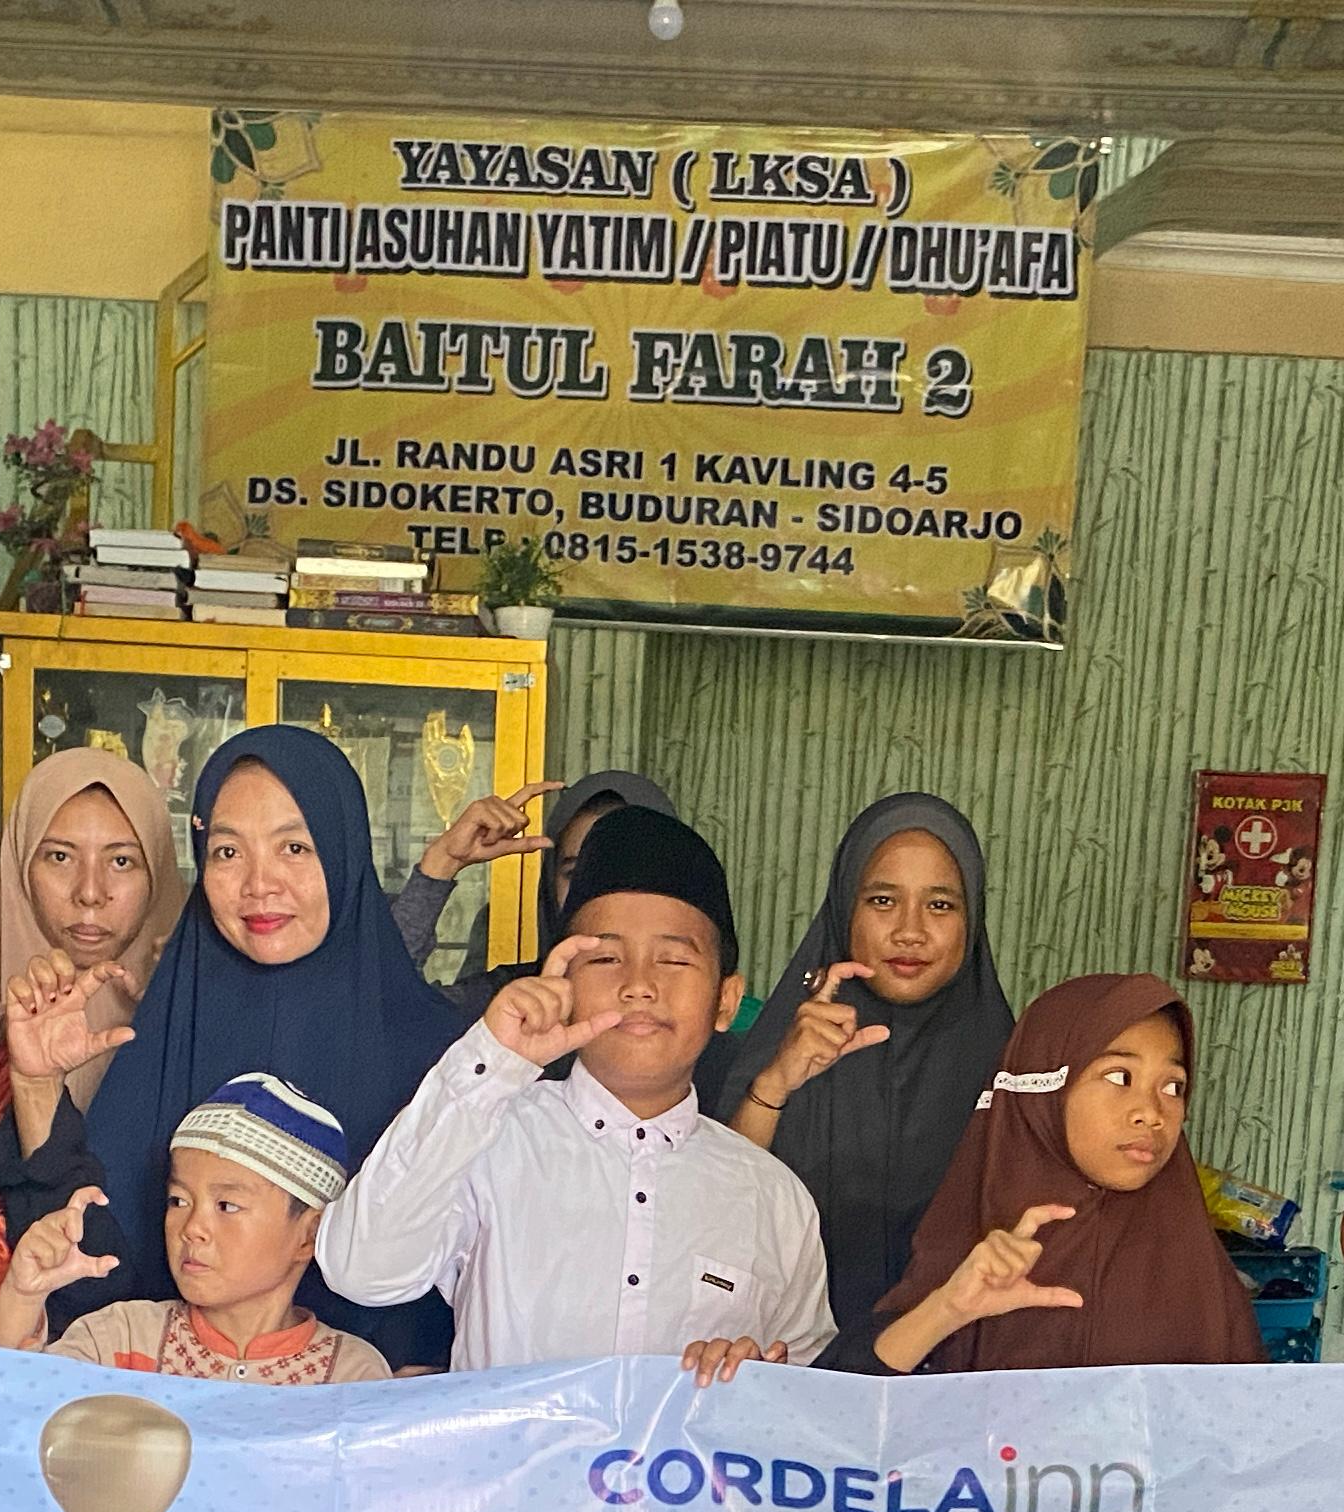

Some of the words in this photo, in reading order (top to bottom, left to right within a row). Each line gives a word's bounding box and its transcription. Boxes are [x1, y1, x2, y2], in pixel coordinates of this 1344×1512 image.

[393, 139, 654, 197] YAYASAN
[711, 149, 874, 206] LKSA
[222, 203, 348, 270] PANTI
[355, 208, 526, 275] ASUHAN
[537, 212, 668, 279] YATIM
[717, 219, 843, 285] PIATU
[889, 226, 1075, 297] DHU'AFA
[312, 318, 608, 397] BAITUL
[629, 328, 901, 412] FARAH
[924, 348, 971, 416] 2
[325, 439, 382, 471] JL.
[396, 440, 537, 475] RANDU
[549, 447, 644, 480] ASRI
[659, 452, 678, 481] 1
[695, 453, 875, 492] KAVLING
[888, 463, 949, 495] 4-5
[247, 477, 308, 506] DS.
[322, 478, 565, 523] SIDOKERTO,
[579, 492, 779, 530] BUDURAN
[817, 503, 1023, 540] SIDOARJO
[544, 531, 854, 577] 0815-1538-9744
[1212, 797, 1267, 810] KOTAK
[1271, 799, 1303, 812] P3K
